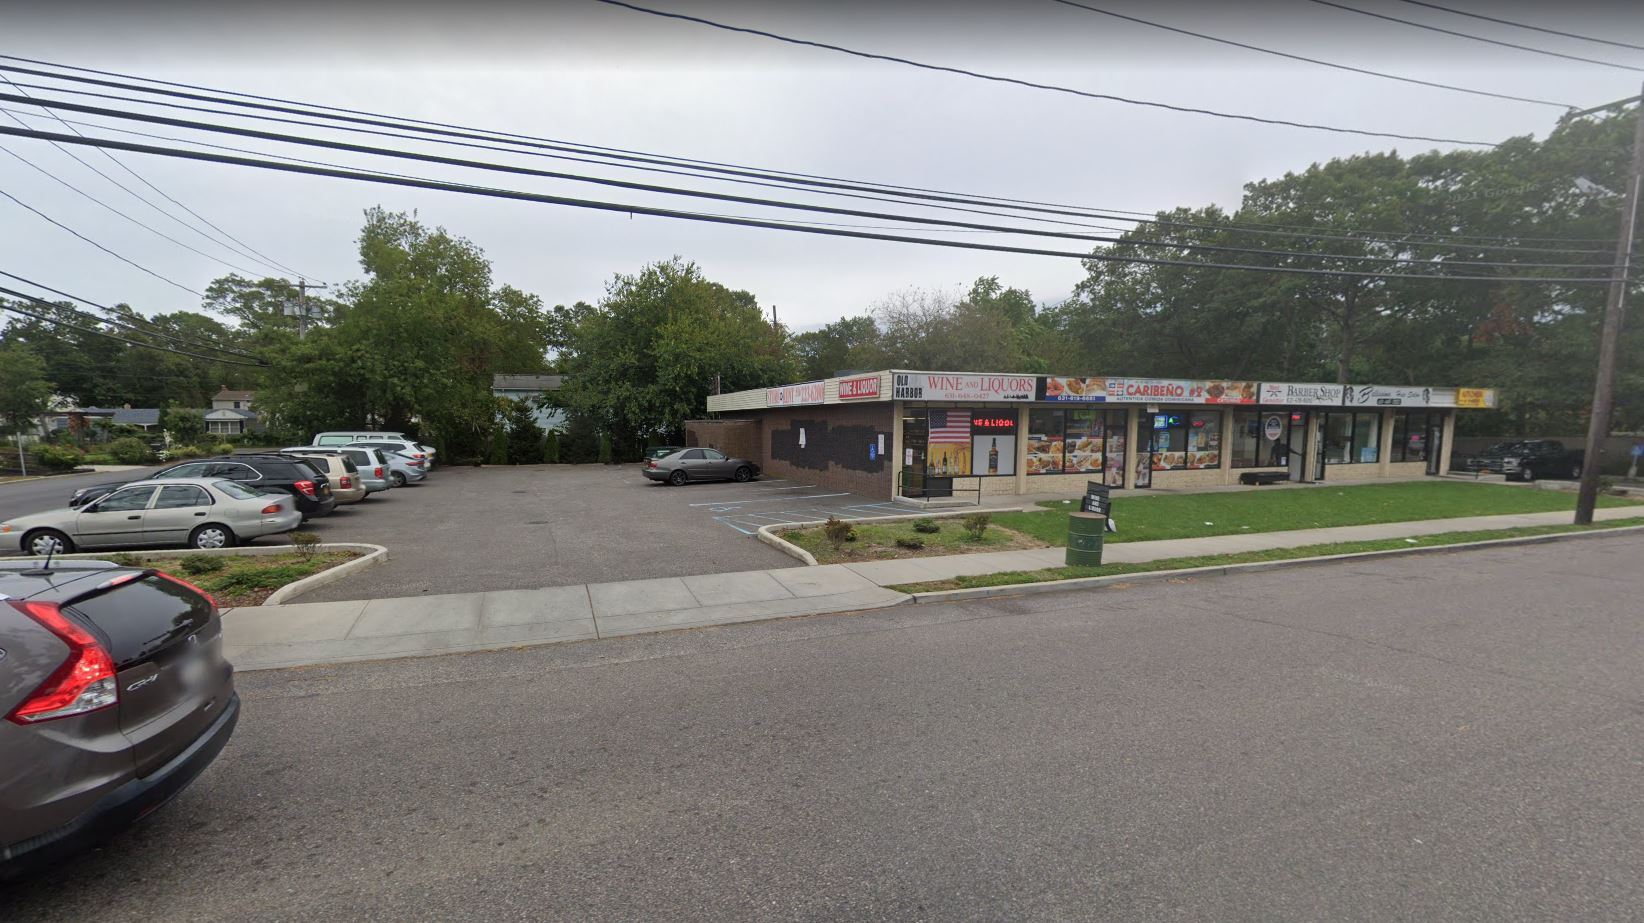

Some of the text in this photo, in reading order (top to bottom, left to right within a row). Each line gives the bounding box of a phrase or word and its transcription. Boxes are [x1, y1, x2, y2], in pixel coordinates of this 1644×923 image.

[896, 375, 909, 386] OLD
[927, 376, 1034, 395] WINE AND LIQUORS
[895, 387, 923, 399] HARBOR
[1126, 383, 1185, 397] CARIBEÑO
[1287, 385, 1318, 399] BARBER
[1320, 385, 1341, 398] SHOP
